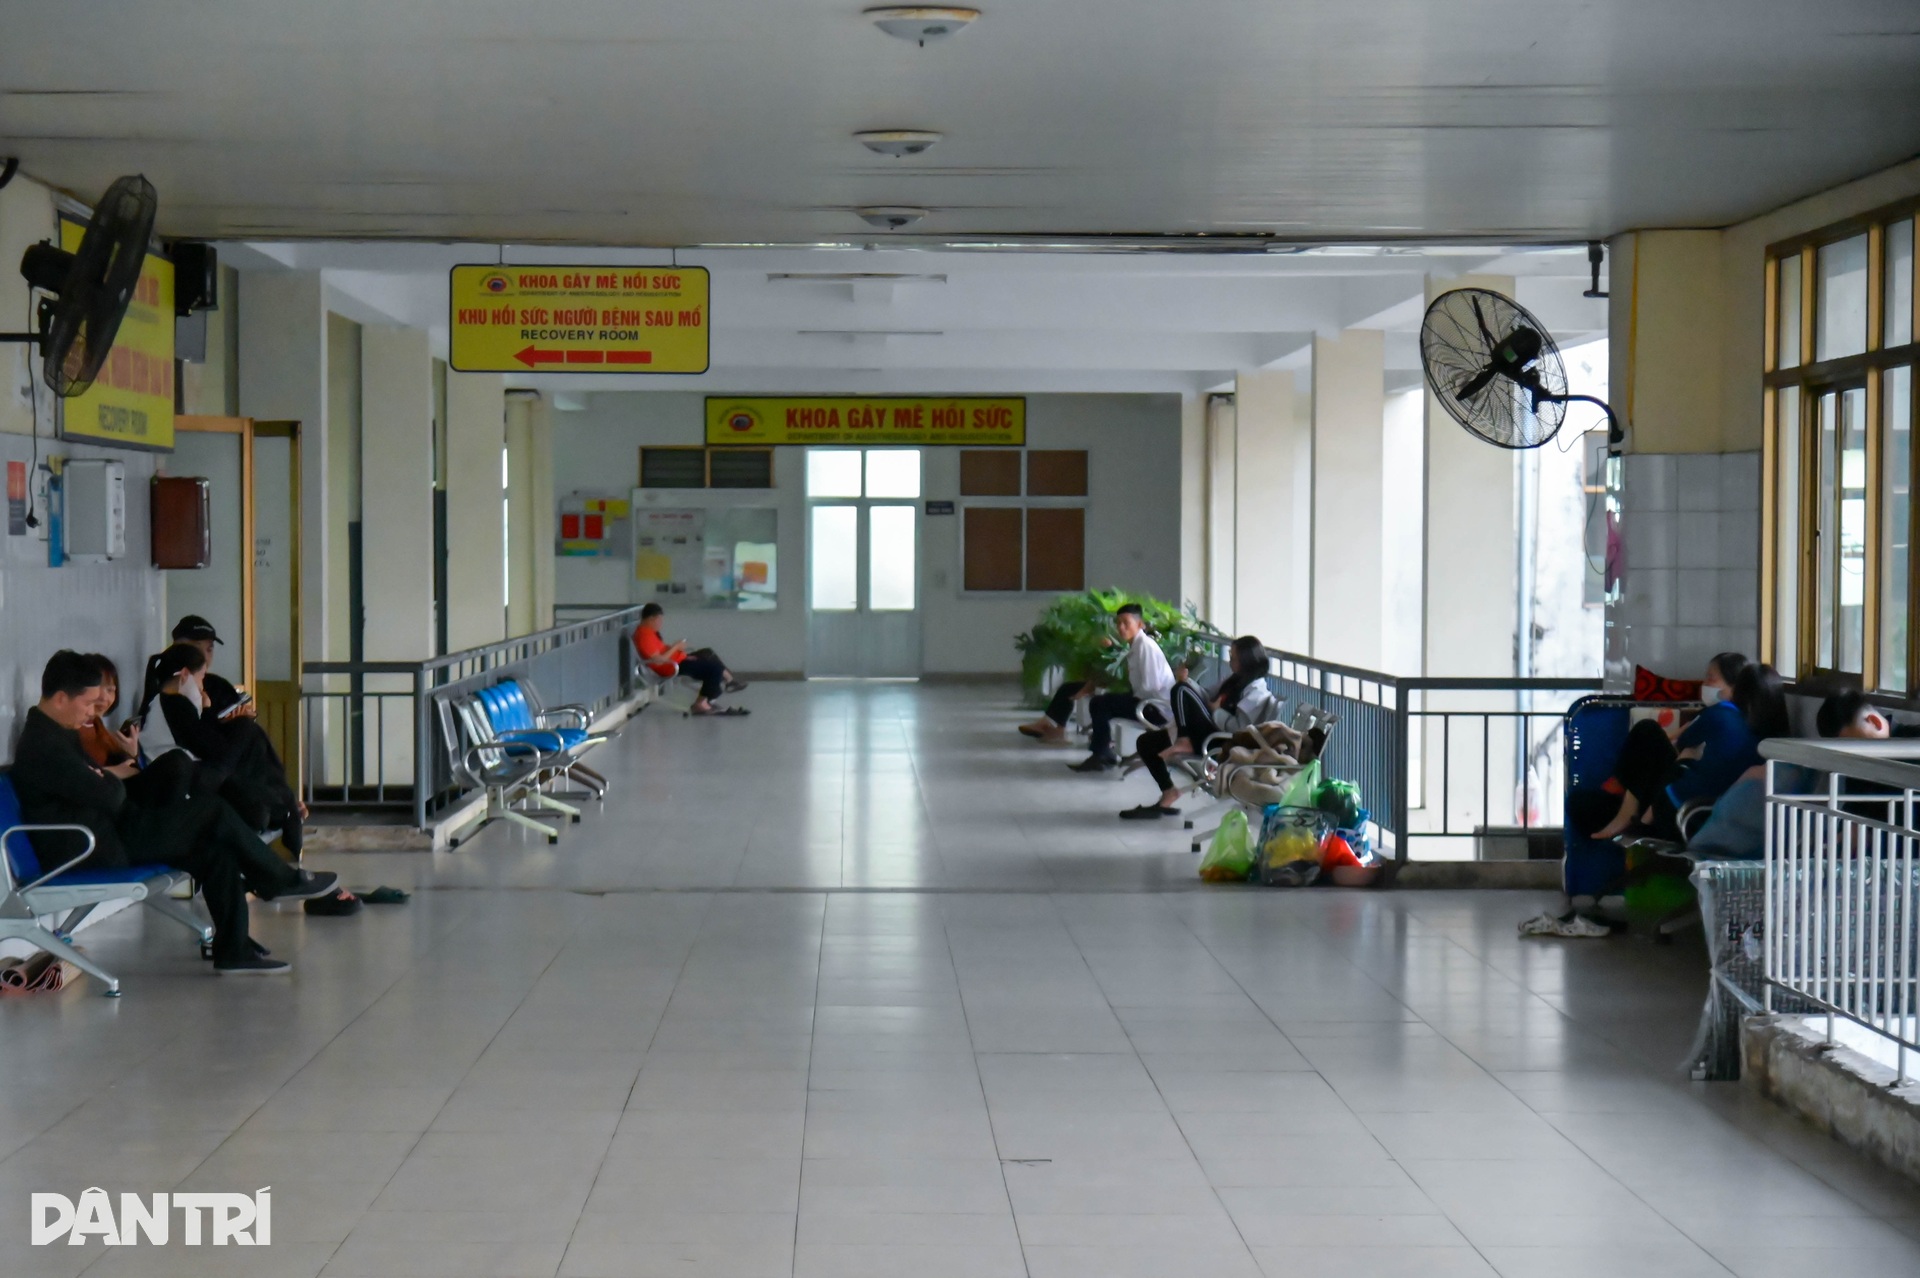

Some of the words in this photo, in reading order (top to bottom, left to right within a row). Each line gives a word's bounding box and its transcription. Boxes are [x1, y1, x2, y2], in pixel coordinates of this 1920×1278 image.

[519, 274, 558, 289] KHOA
[563, 273, 591, 289] GÂY
[596, 272, 617, 289] MÊ
[653, 273, 681, 289] SỨC
[458, 309, 487, 325] KHU
[520, 306, 548, 326] SỨC
[553, 306, 597, 326] NGƯỜI
[602, 307, 640, 330] BỆNH
[645, 310, 673, 327] SAU
[520, 329, 594, 340] RECOVERY
[599, 330, 639, 341] ROOM
[786, 408, 840, 429] KHOA
[847, 405, 886, 429] GÂY
[894, 405, 924, 429] MÊ
[972, 404, 1012, 429] SỨC
